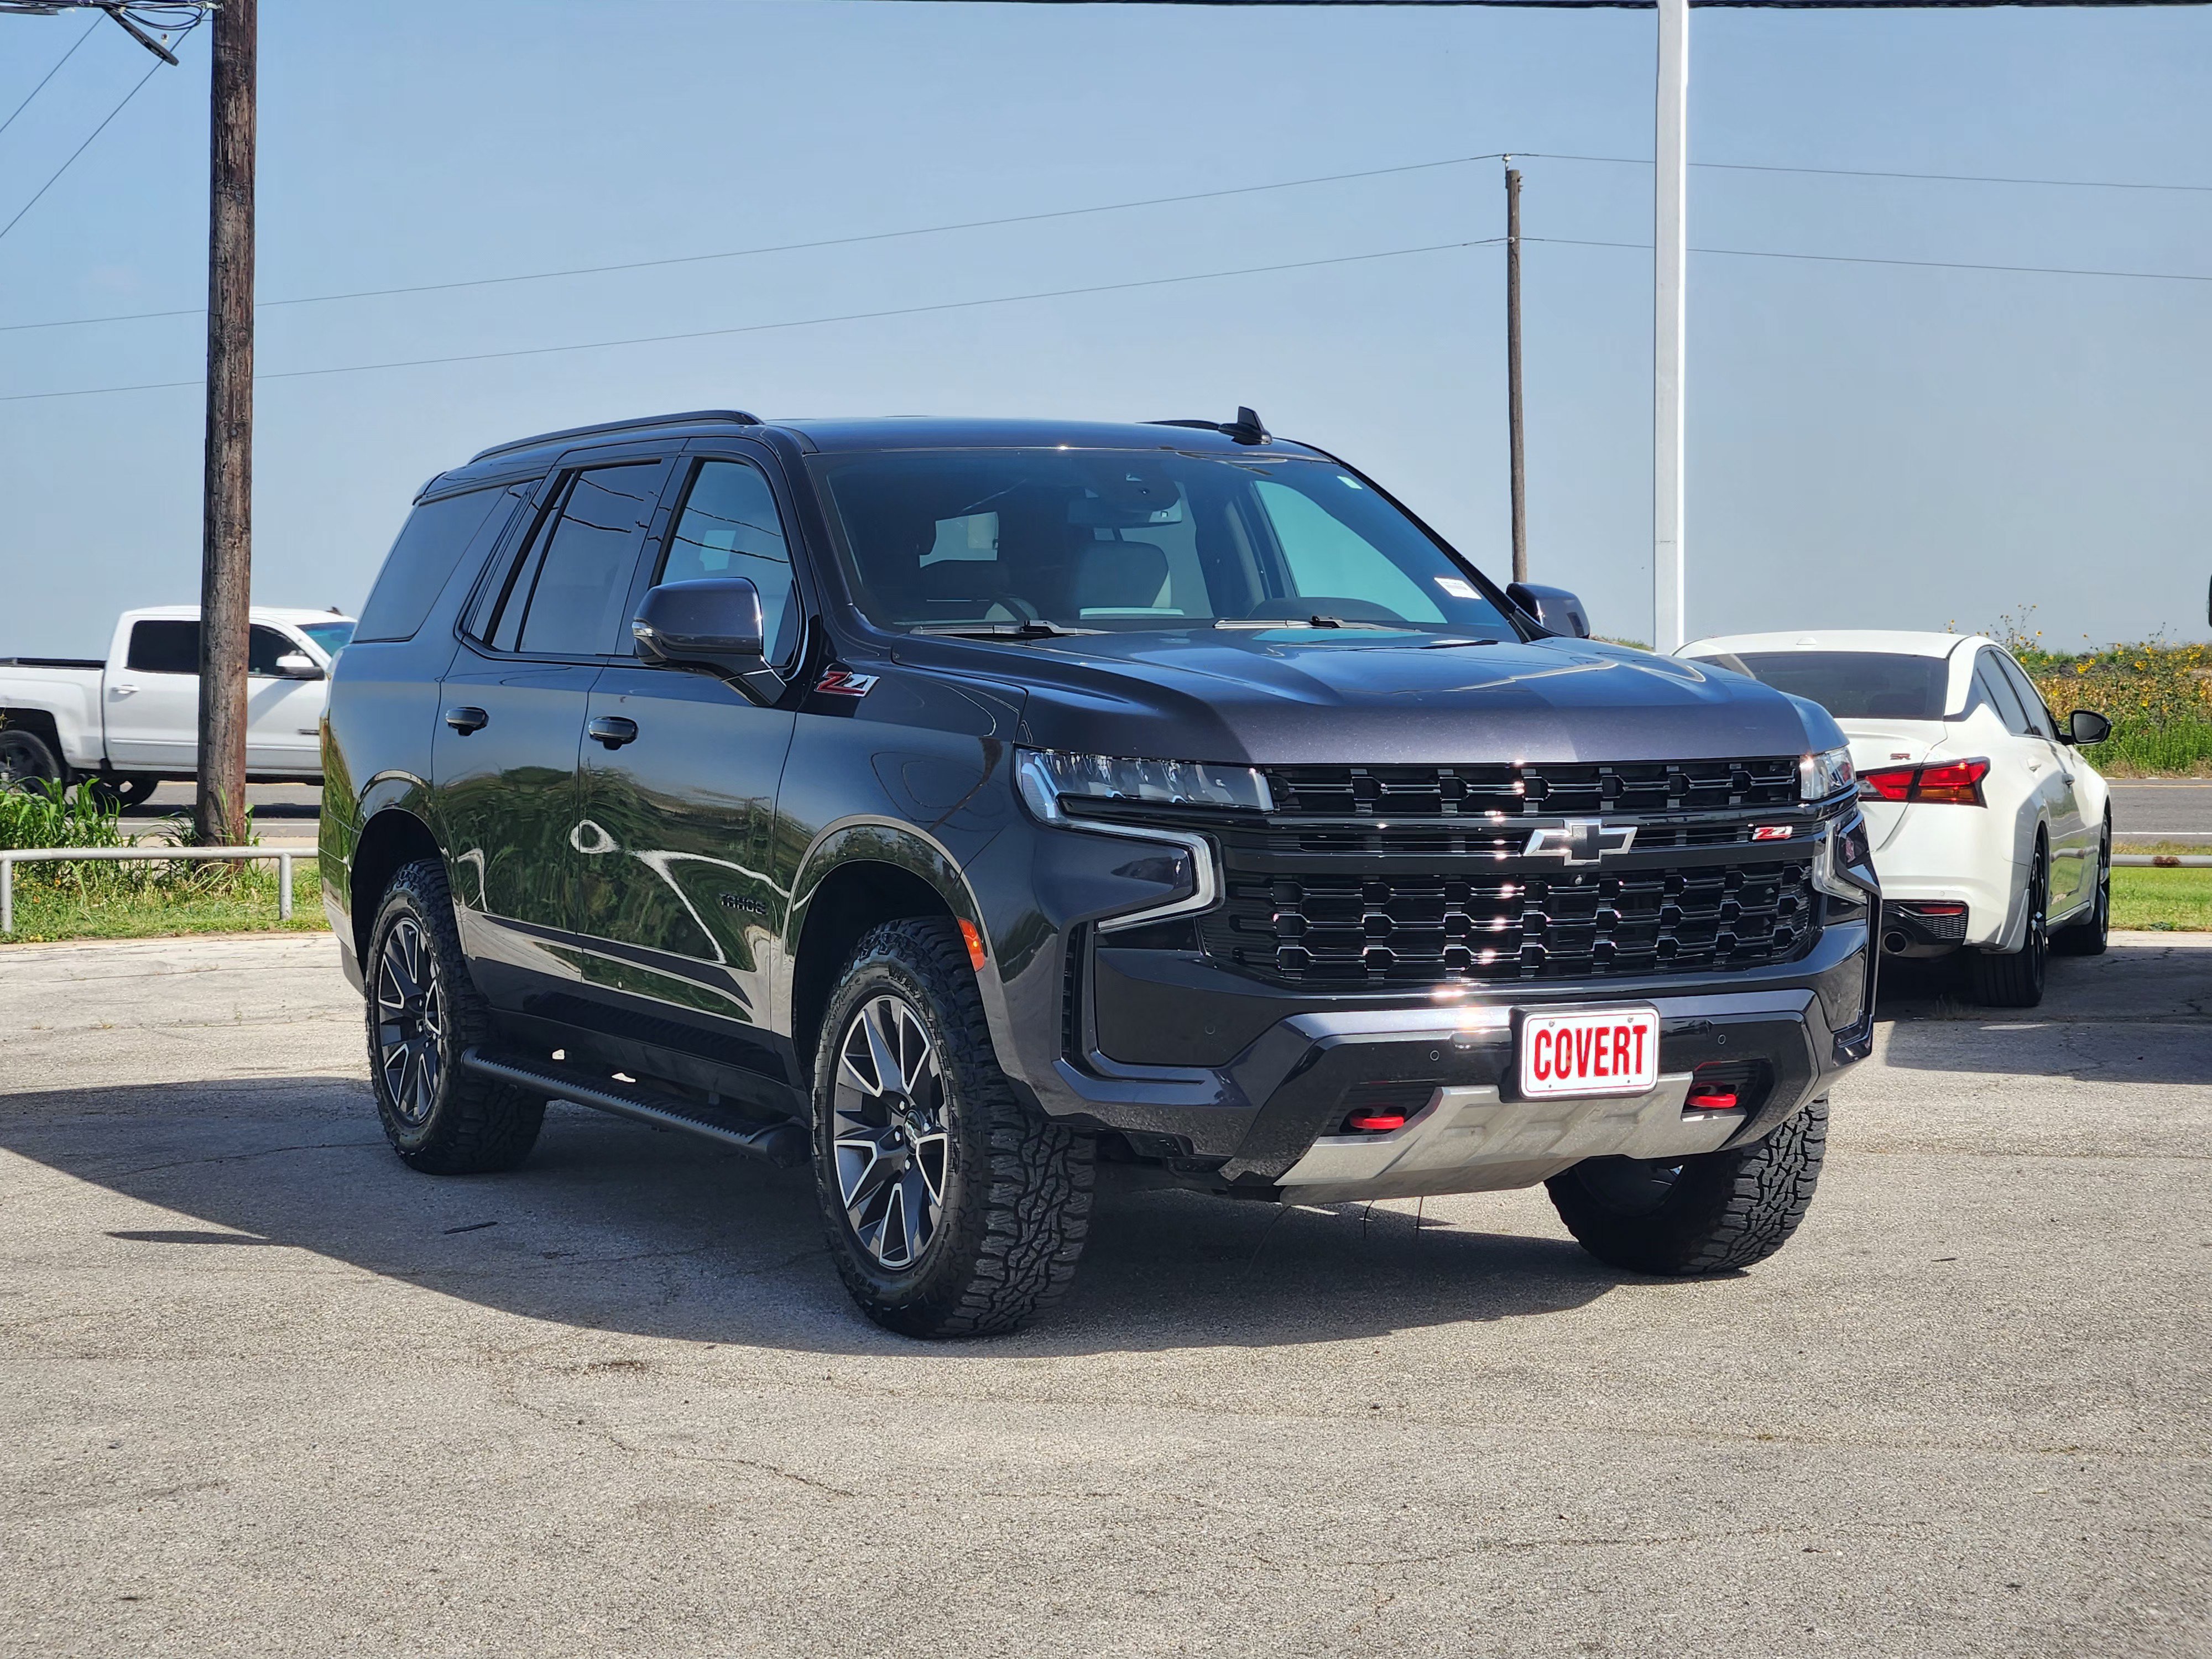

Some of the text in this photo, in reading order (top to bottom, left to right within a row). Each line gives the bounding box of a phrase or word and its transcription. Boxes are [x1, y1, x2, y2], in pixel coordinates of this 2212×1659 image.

[814, 670, 880, 697] Z71
[1752, 826, 1793, 840] Z71
[719, 892, 768, 915] TAHOE
[1533, 1025, 1647, 1081] COVERT
